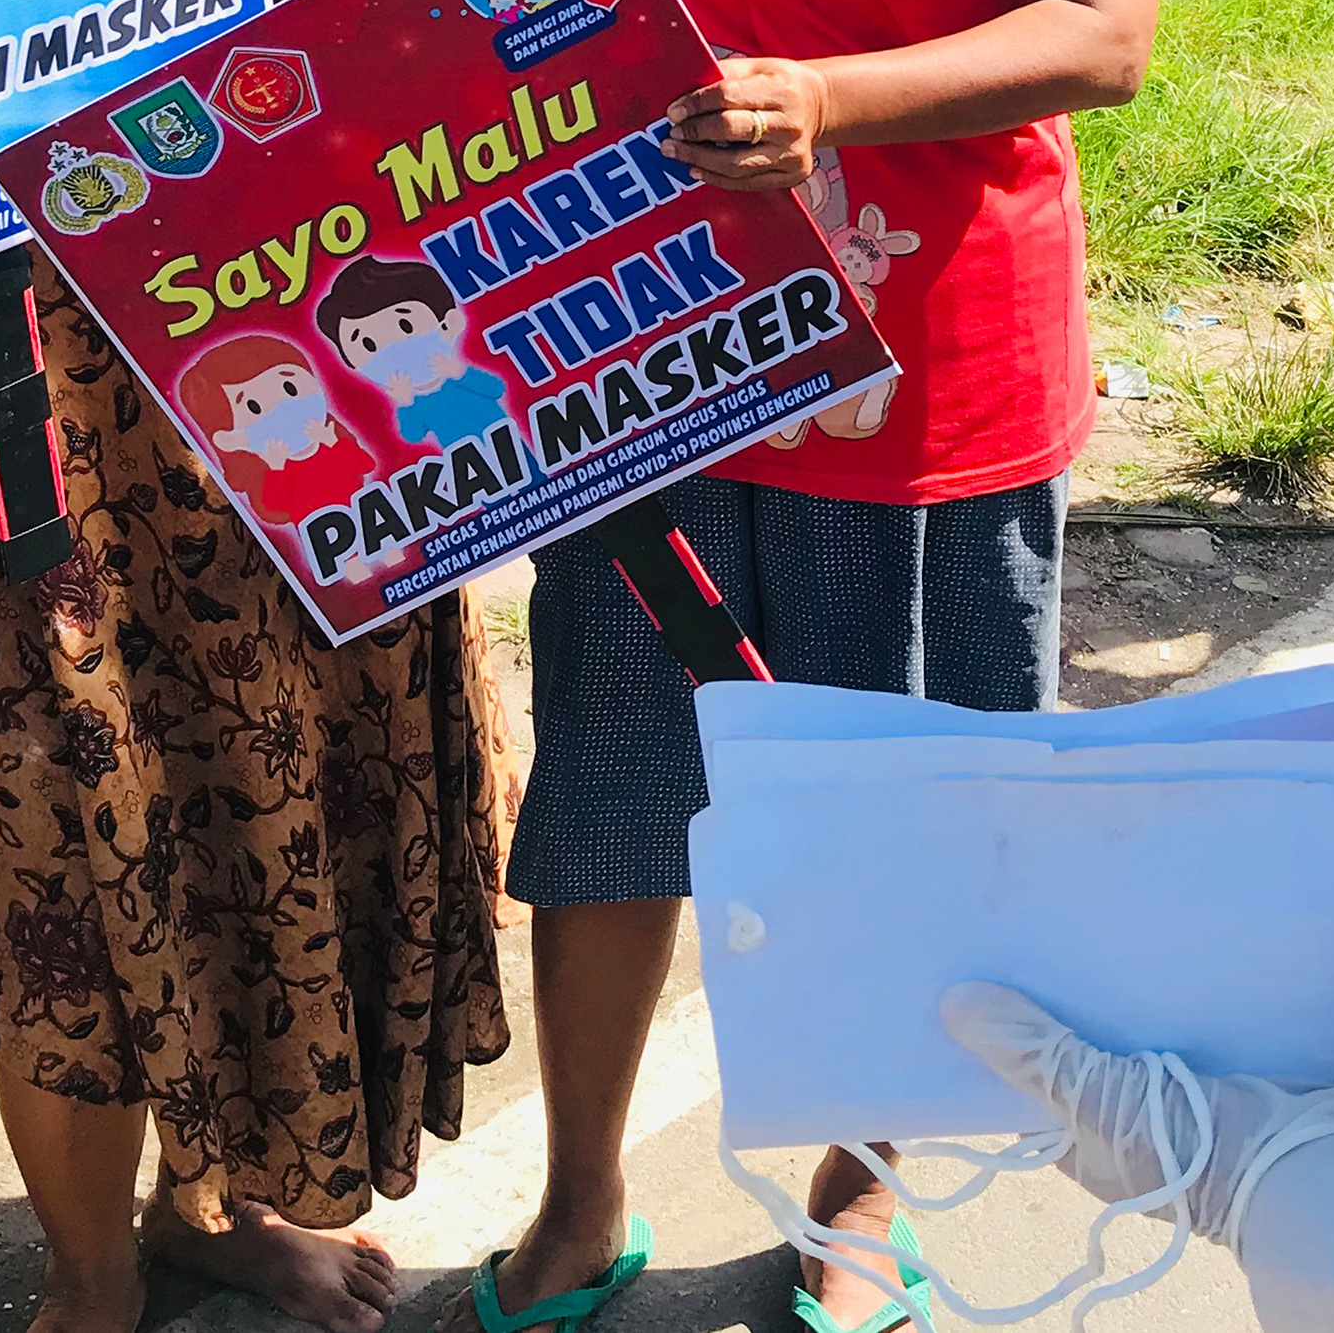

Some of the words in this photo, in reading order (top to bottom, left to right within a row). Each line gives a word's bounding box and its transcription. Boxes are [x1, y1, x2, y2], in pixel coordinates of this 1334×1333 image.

[504, 16, 557, 50] SAYANGI
[558, 1, 585, 23] DIRI
[513, 41, 539, 63] DAN
[540, 8, 606, 49] KELUARGA
[144, 200, 370, 339] Sayo
[376, 78, 598, 223] Malu
[422, 119, 703, 302] KAREN
[485, 220, 742, 387] TIDAK
[305, 423, 523, 584] PAKAI
[540, 272, 842, 475] MASKER
[384, 554, 471, 605] PERCEPATAN
[472, 511, 563, 563] PENANGANAN
[563, 475, 624, 518] PANDEMI
[625, 444, 689, 484] COVID-19
[688, 409, 757, 456] PROVINSI
[757, 372, 832, 421] BENGKULU
[425, 523, 479, 559] SATGAS
[482, 476, 575, 530] PENGAMANAN
[576, 462, 604, 488] DAN
[606, 430, 669, 469] GAKKUM
[668, 406, 719, 442] GUGUS
[718, 380, 768, 417] TUGAS
